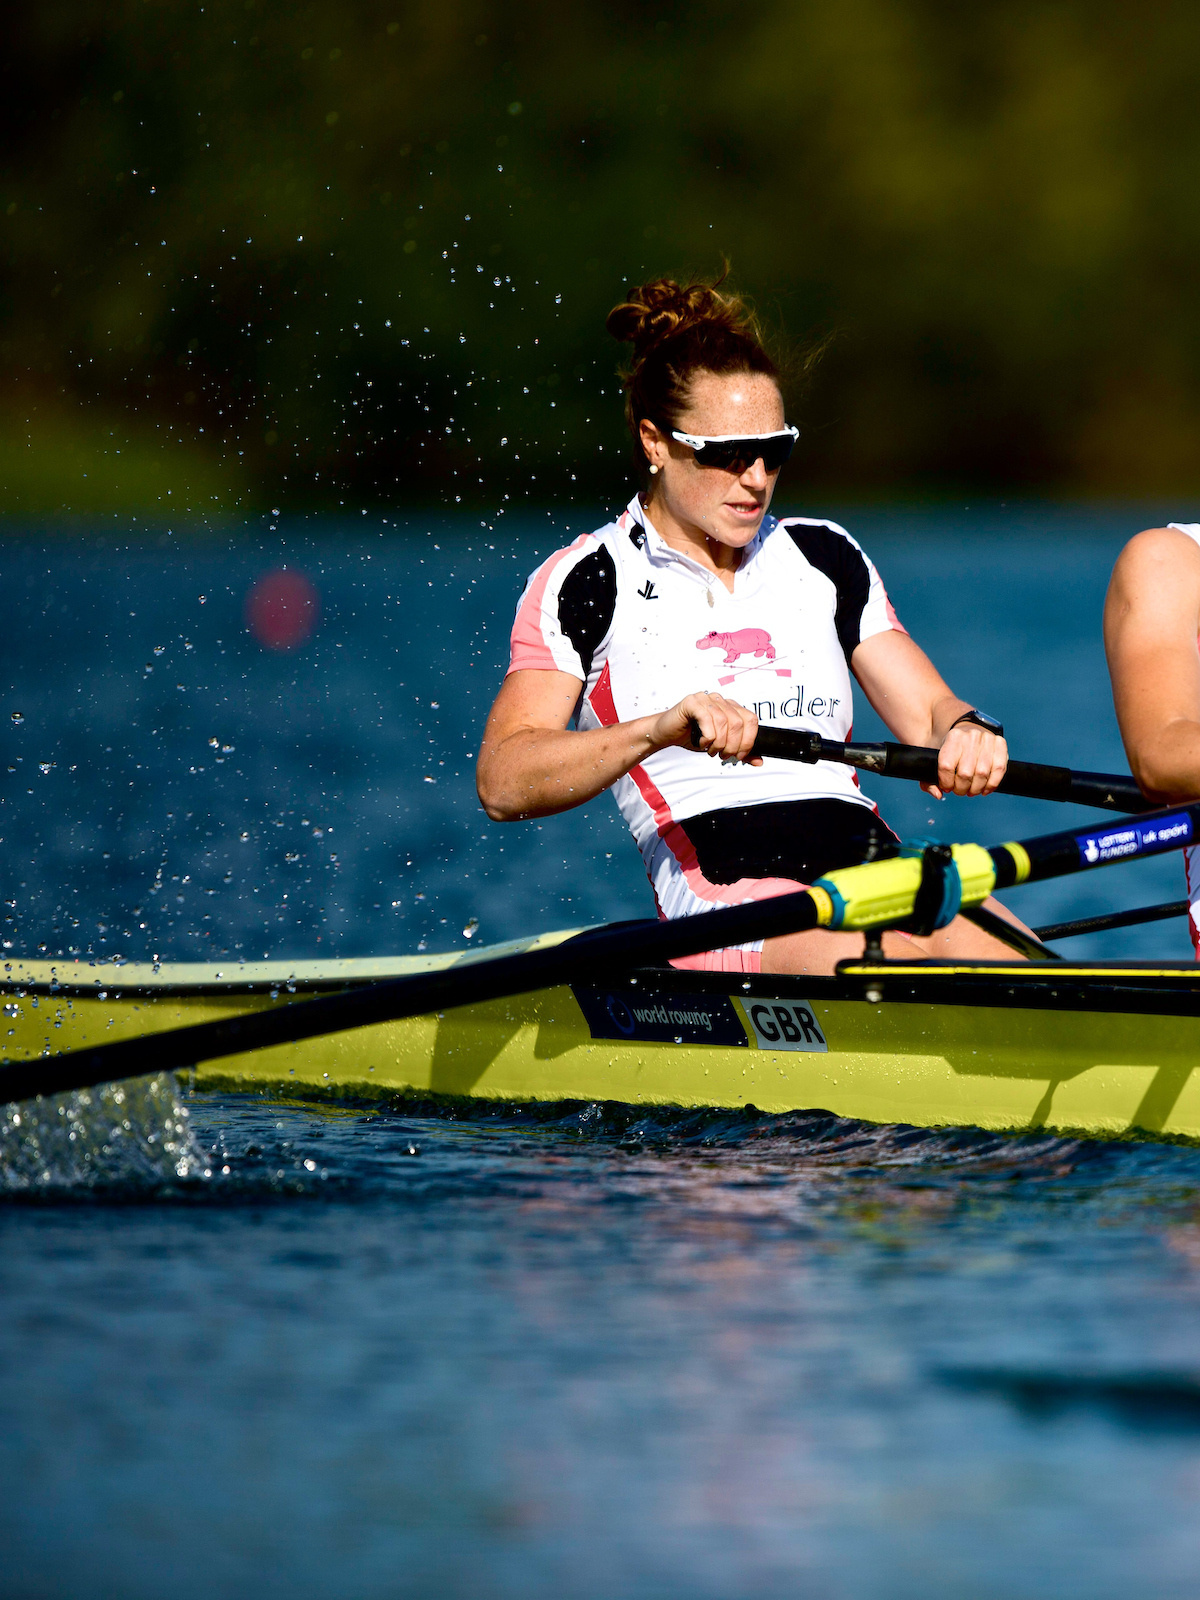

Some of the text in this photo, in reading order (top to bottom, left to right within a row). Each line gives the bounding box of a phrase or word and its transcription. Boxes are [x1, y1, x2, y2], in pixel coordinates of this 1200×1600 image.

[743, 685, 841, 721] nder
[1142, 823, 1188, 844] uk sport
[1100, 842, 1138, 858] FUNDED
[633, 1005, 713, 1032] world rowing
[751, 1004, 825, 1044] GBR
